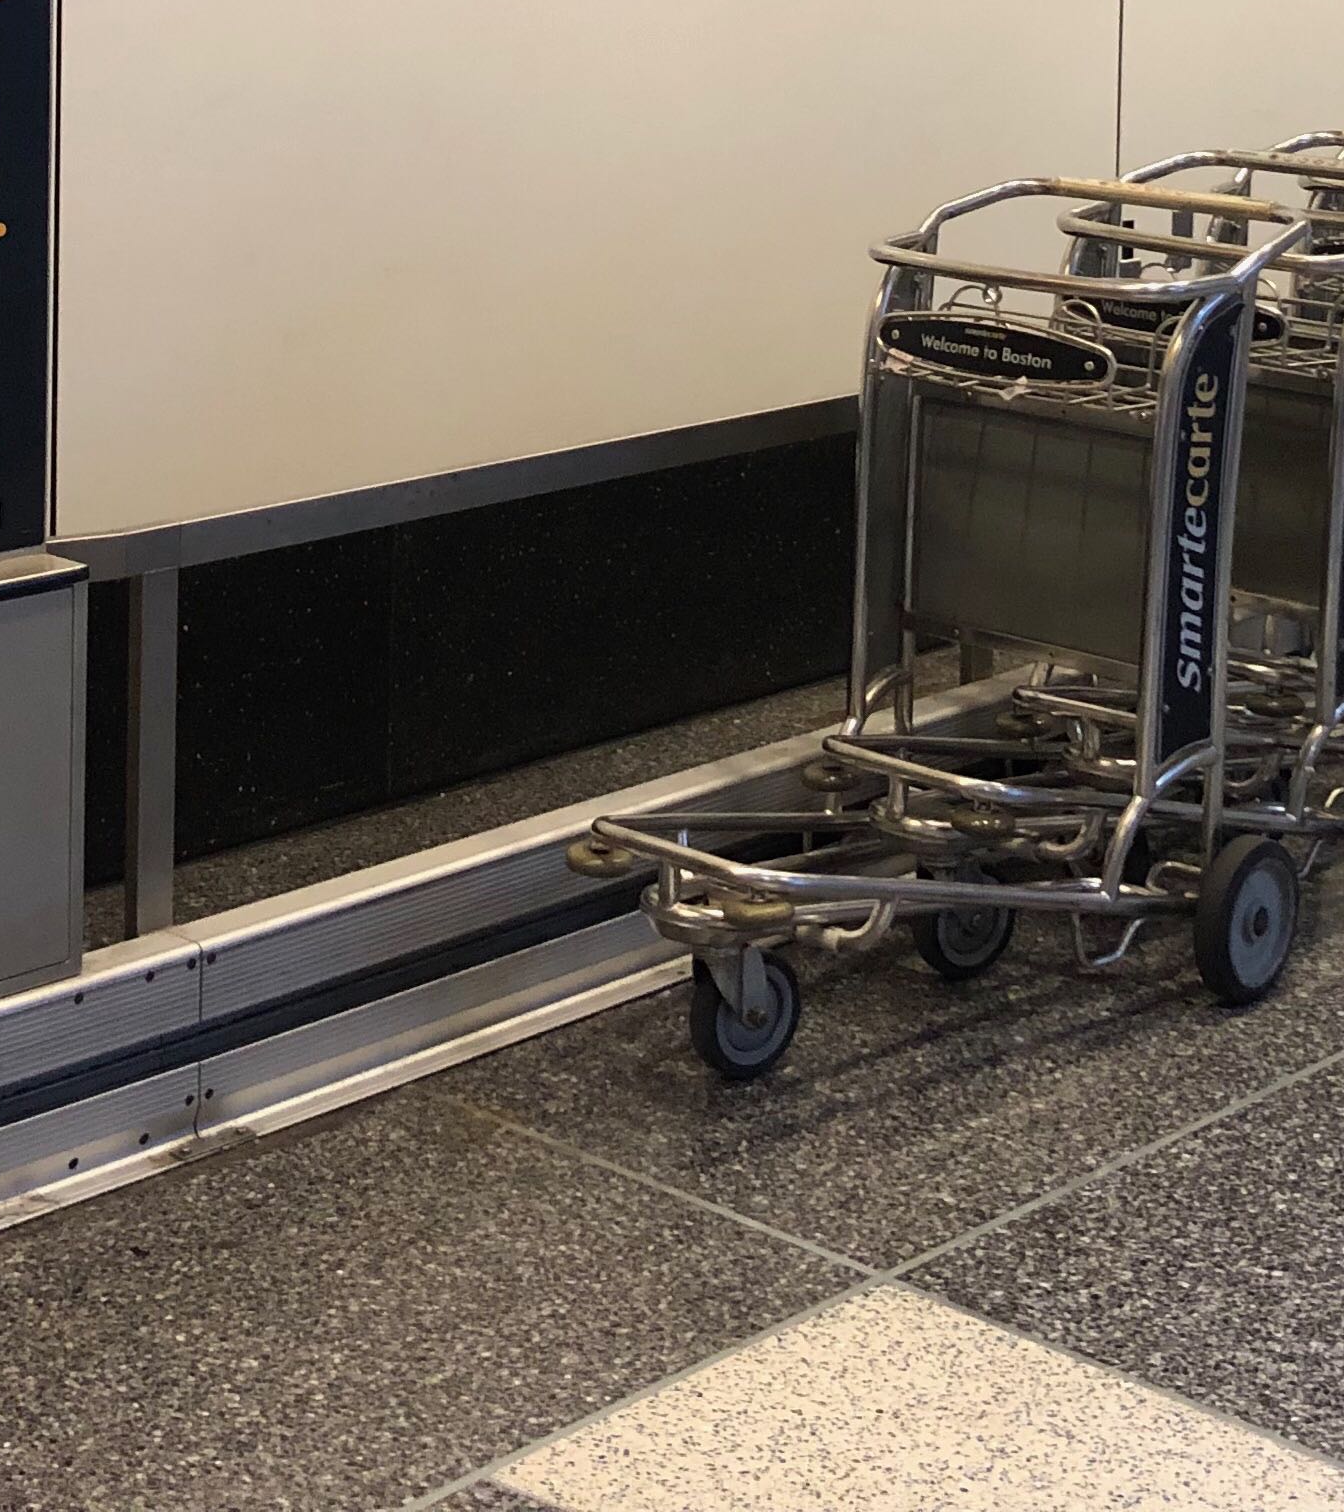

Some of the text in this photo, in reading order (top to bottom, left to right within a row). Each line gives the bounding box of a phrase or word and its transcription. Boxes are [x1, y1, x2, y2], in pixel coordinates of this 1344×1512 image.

[1102, 299, 1157, 321] Welcome
[920, 333, 980, 357] Welcome
[983, 345, 998, 361] to
[1001, 347, 1052, 370] Boston
[1176, 372, 1219, 693] smartecarte
